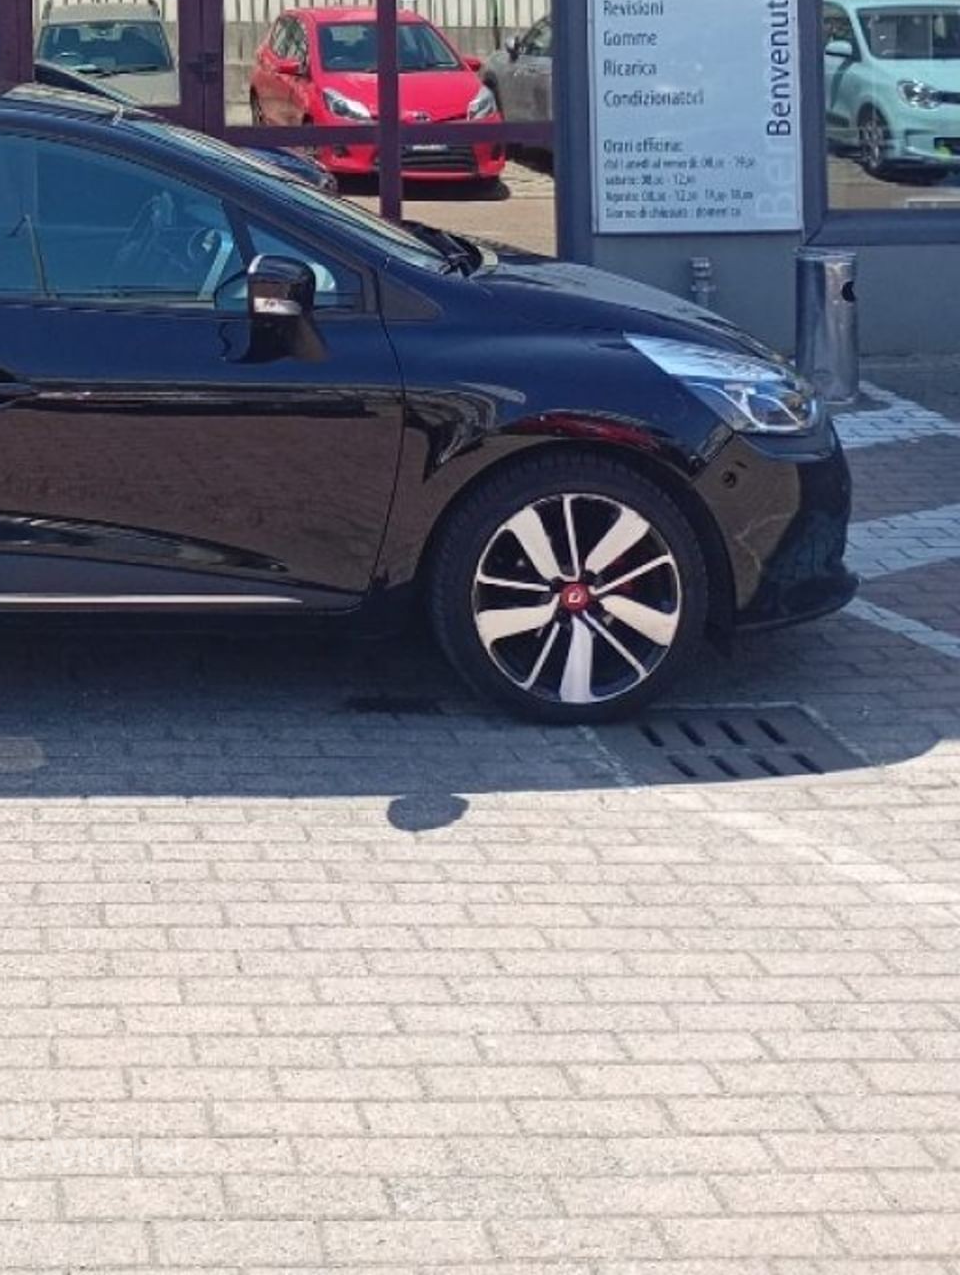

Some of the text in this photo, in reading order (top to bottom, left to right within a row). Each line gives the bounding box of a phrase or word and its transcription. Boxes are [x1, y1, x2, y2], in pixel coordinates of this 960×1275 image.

[603, 0, 664, 17] Revisioni
[603, 31, 658, 47] Gomme
[603, 60, 658, 77] Ricarica
[603, 89, 705, 109] Condizionatori
[603, 139, 633, 153] Orari
